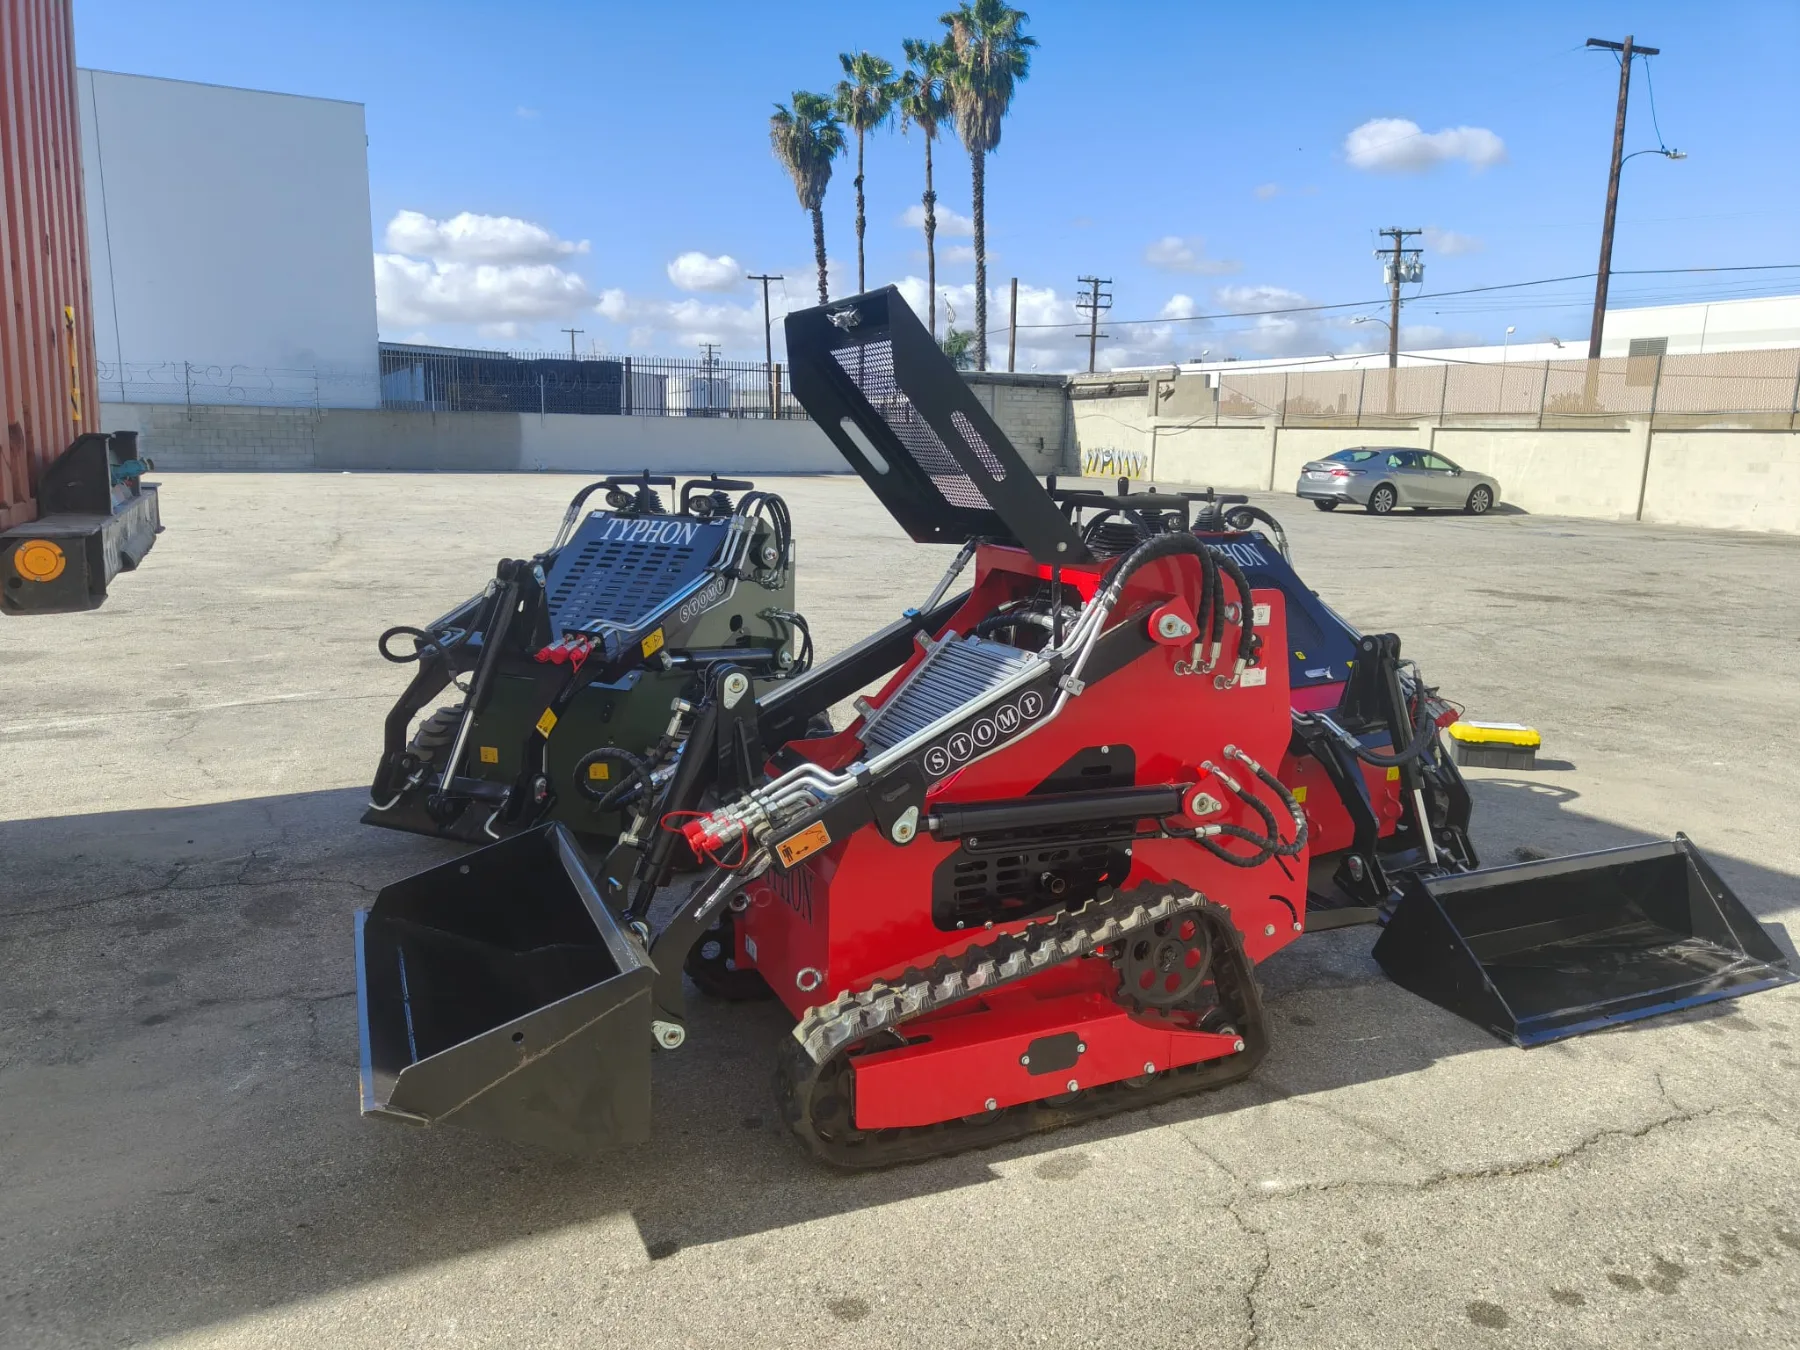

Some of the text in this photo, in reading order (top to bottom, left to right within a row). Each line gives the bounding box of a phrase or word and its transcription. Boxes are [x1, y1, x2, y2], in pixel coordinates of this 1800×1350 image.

[600, 517, 702, 545] TYPHON
[681, 578, 725, 622] STOMP
[926, 692, 1042, 773] STOMP
